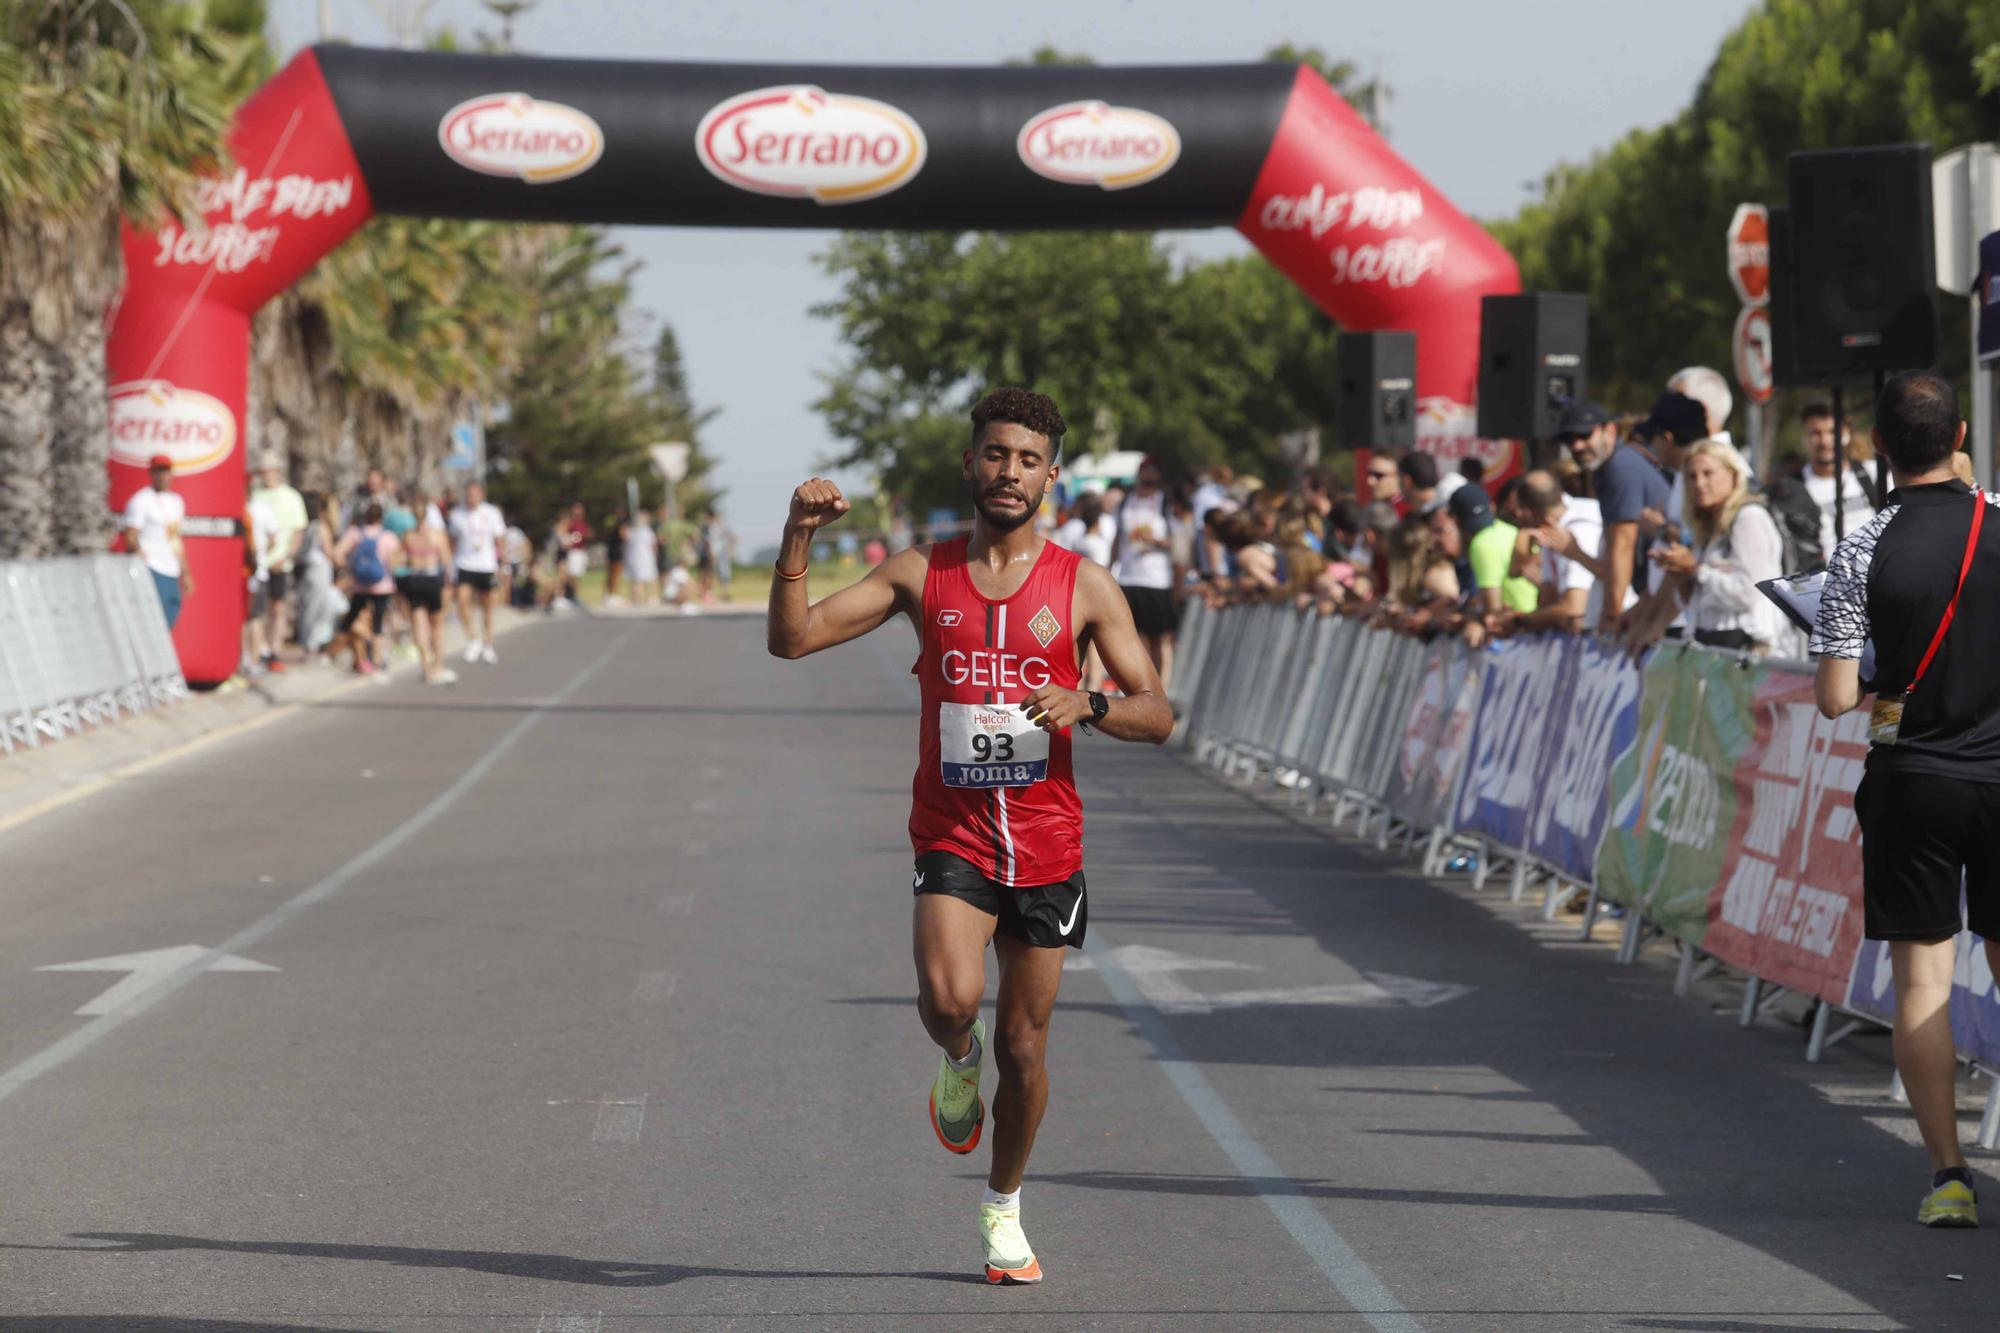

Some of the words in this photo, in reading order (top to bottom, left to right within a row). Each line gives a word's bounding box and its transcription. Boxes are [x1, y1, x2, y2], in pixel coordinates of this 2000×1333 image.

[462, 117, 585, 152] Serrano
[727, 117, 901, 166] Serrano
[1043, 125, 1161, 160] Serrano
[1734, 242, 1769, 268] STO
[971, 732, 1015, 763] 93
